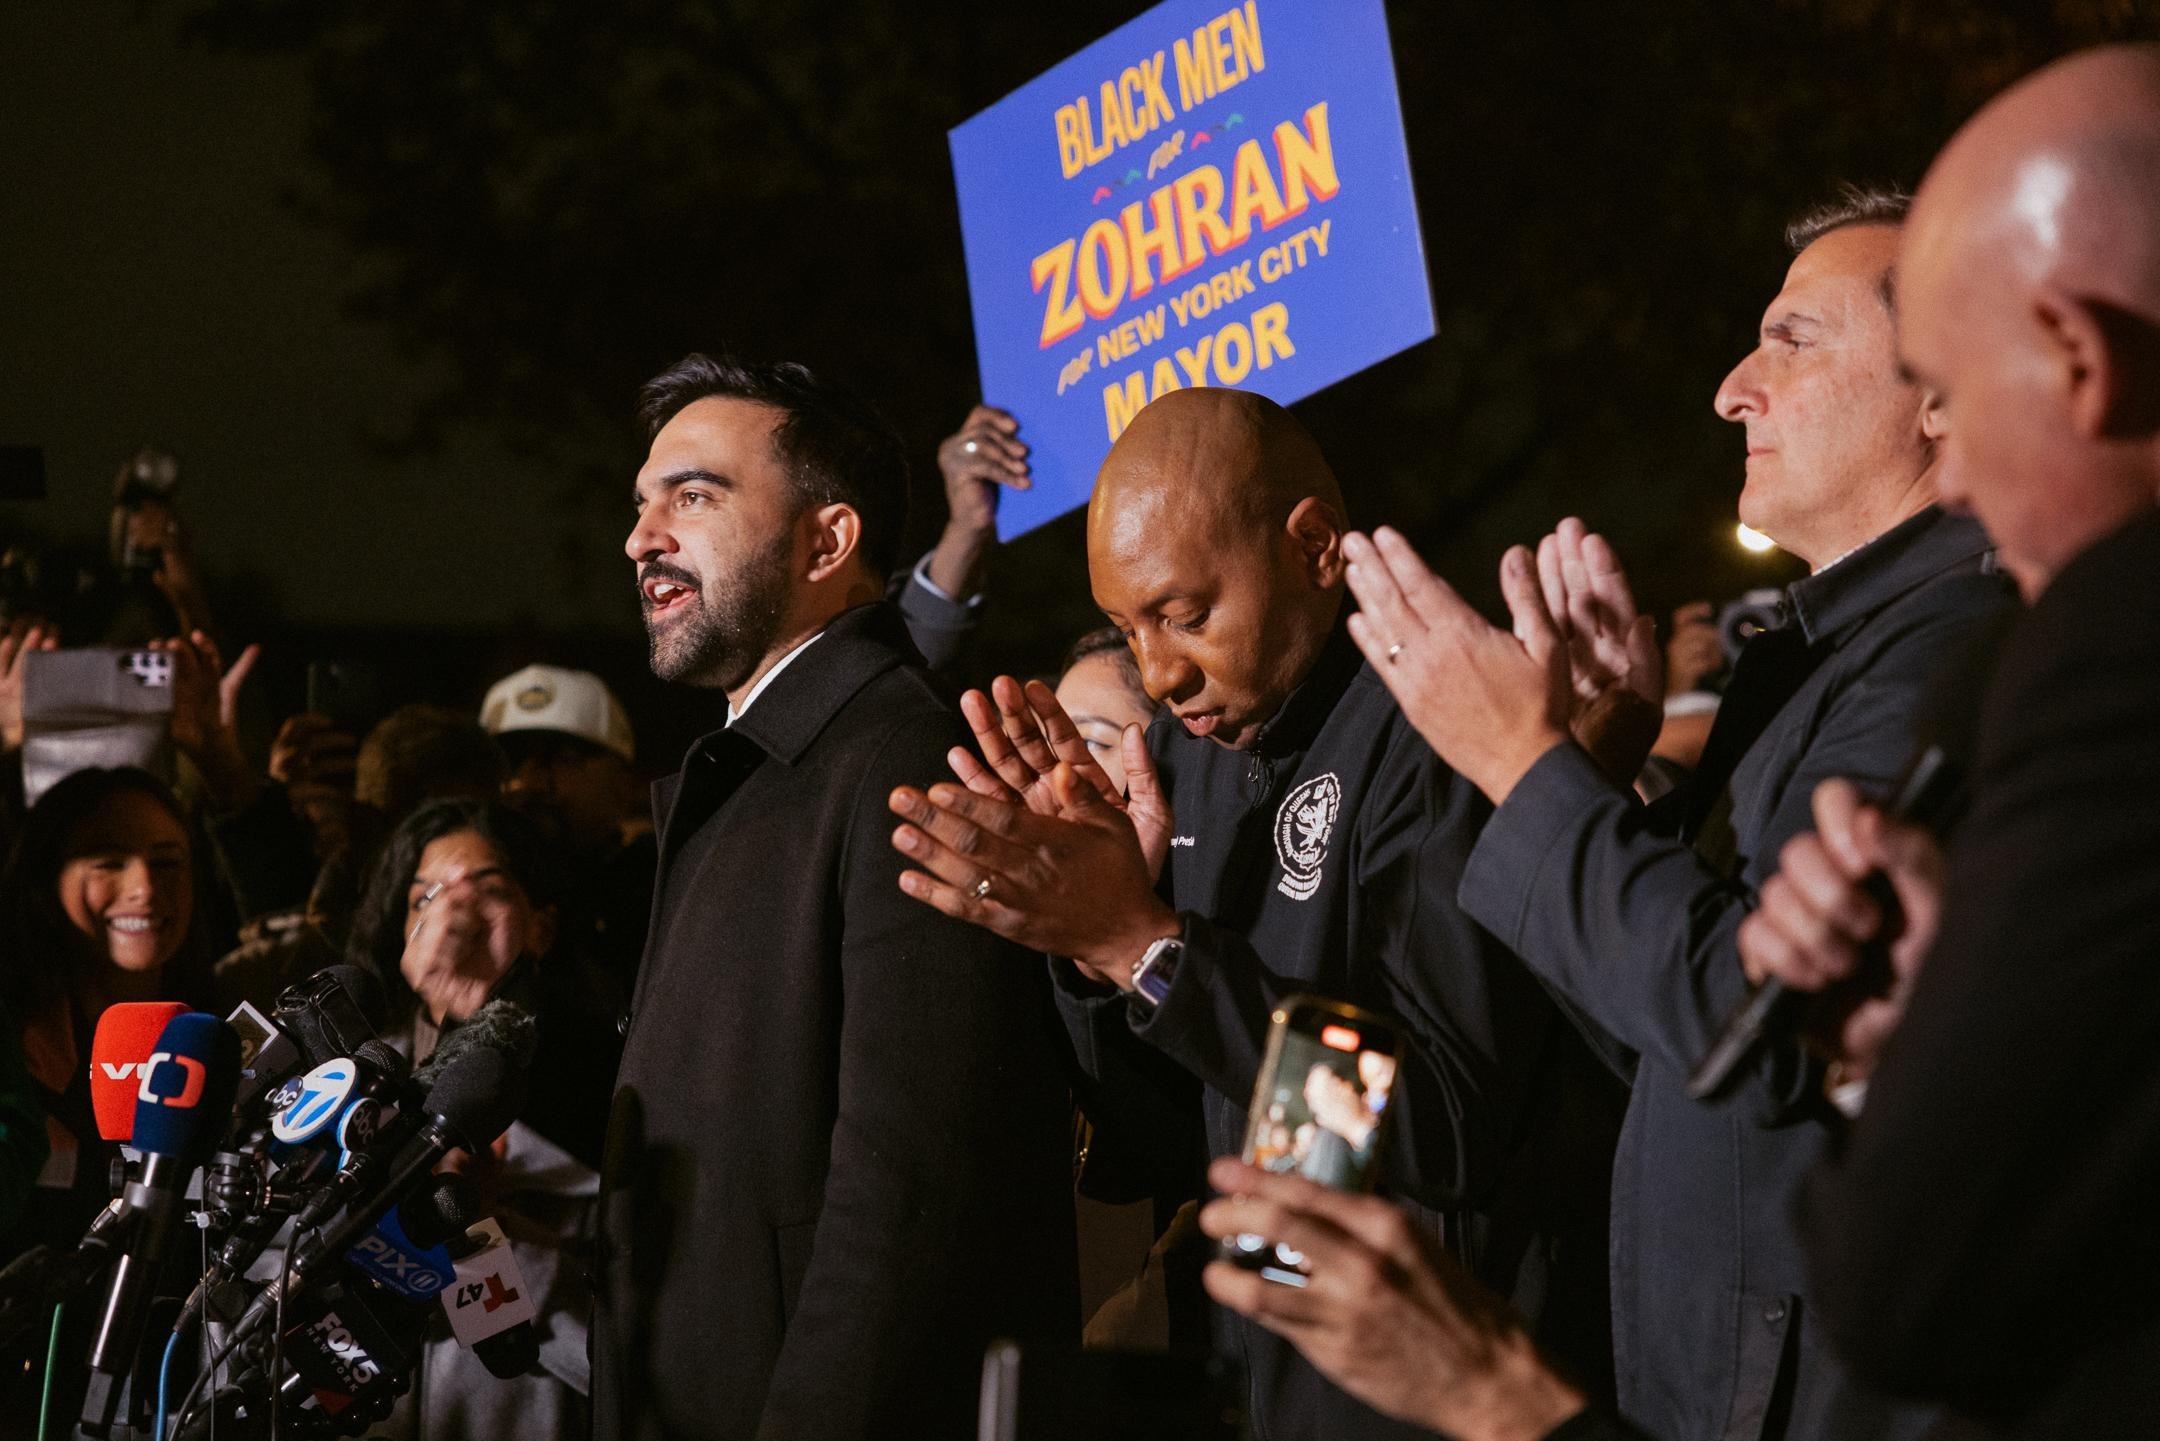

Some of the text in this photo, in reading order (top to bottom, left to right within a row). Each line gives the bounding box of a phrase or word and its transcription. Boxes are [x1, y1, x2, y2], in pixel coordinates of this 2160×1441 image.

[1055, 0, 1265, 179] BLACK MEN
[1030, 101, 1340, 350] ZOHRAN
[1097, 304, 1165, 368] NEW
[1169, 259, 1256, 327] YORK
[1258, 218, 1331, 283] CITY
[456, 1283, 484, 1309] 47
[330, 1357, 359, 1392] YORK
